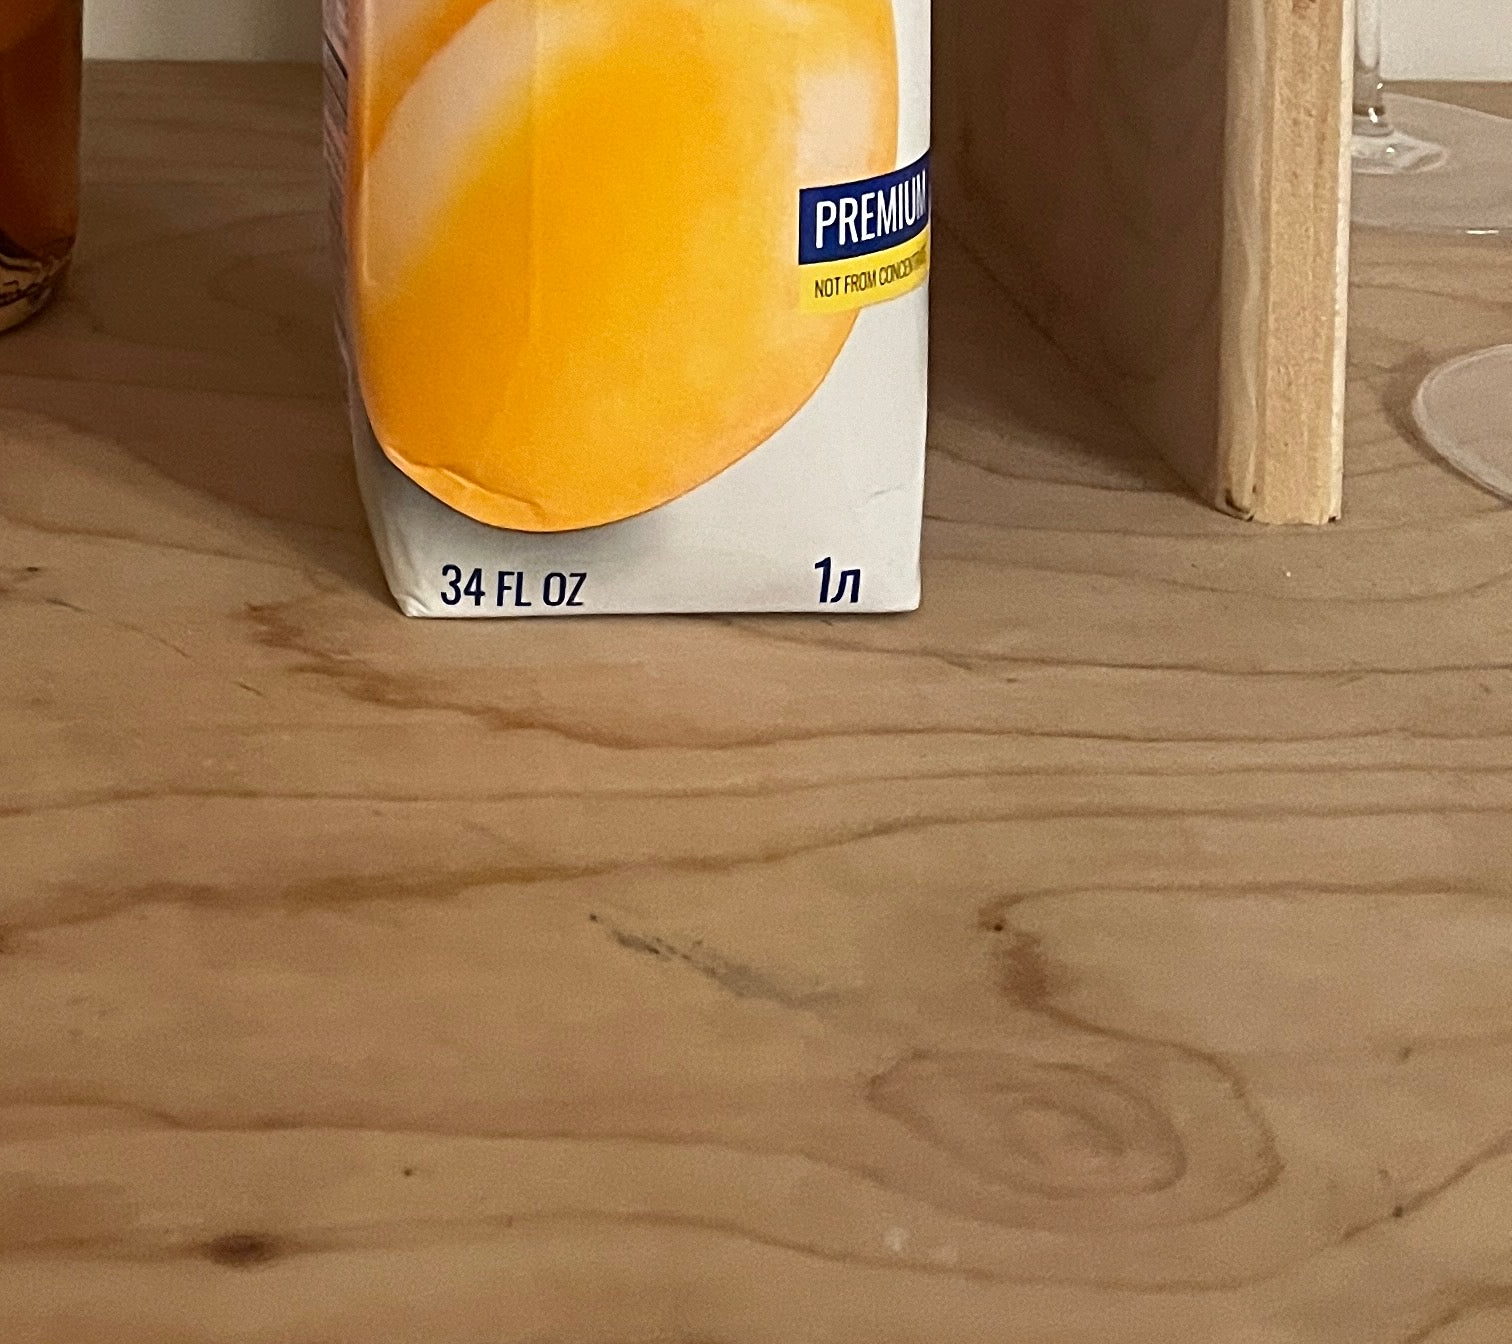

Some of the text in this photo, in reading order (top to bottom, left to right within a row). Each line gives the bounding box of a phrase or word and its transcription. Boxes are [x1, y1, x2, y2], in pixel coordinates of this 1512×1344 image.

[815, 168, 927, 249] PREMIUM
[814, 276, 841, 299] NOT
[843, 269, 877, 295] FROM
[440, 563, 588, 608] 34 FL OZ
[813, 556, 862, 604] 1л
